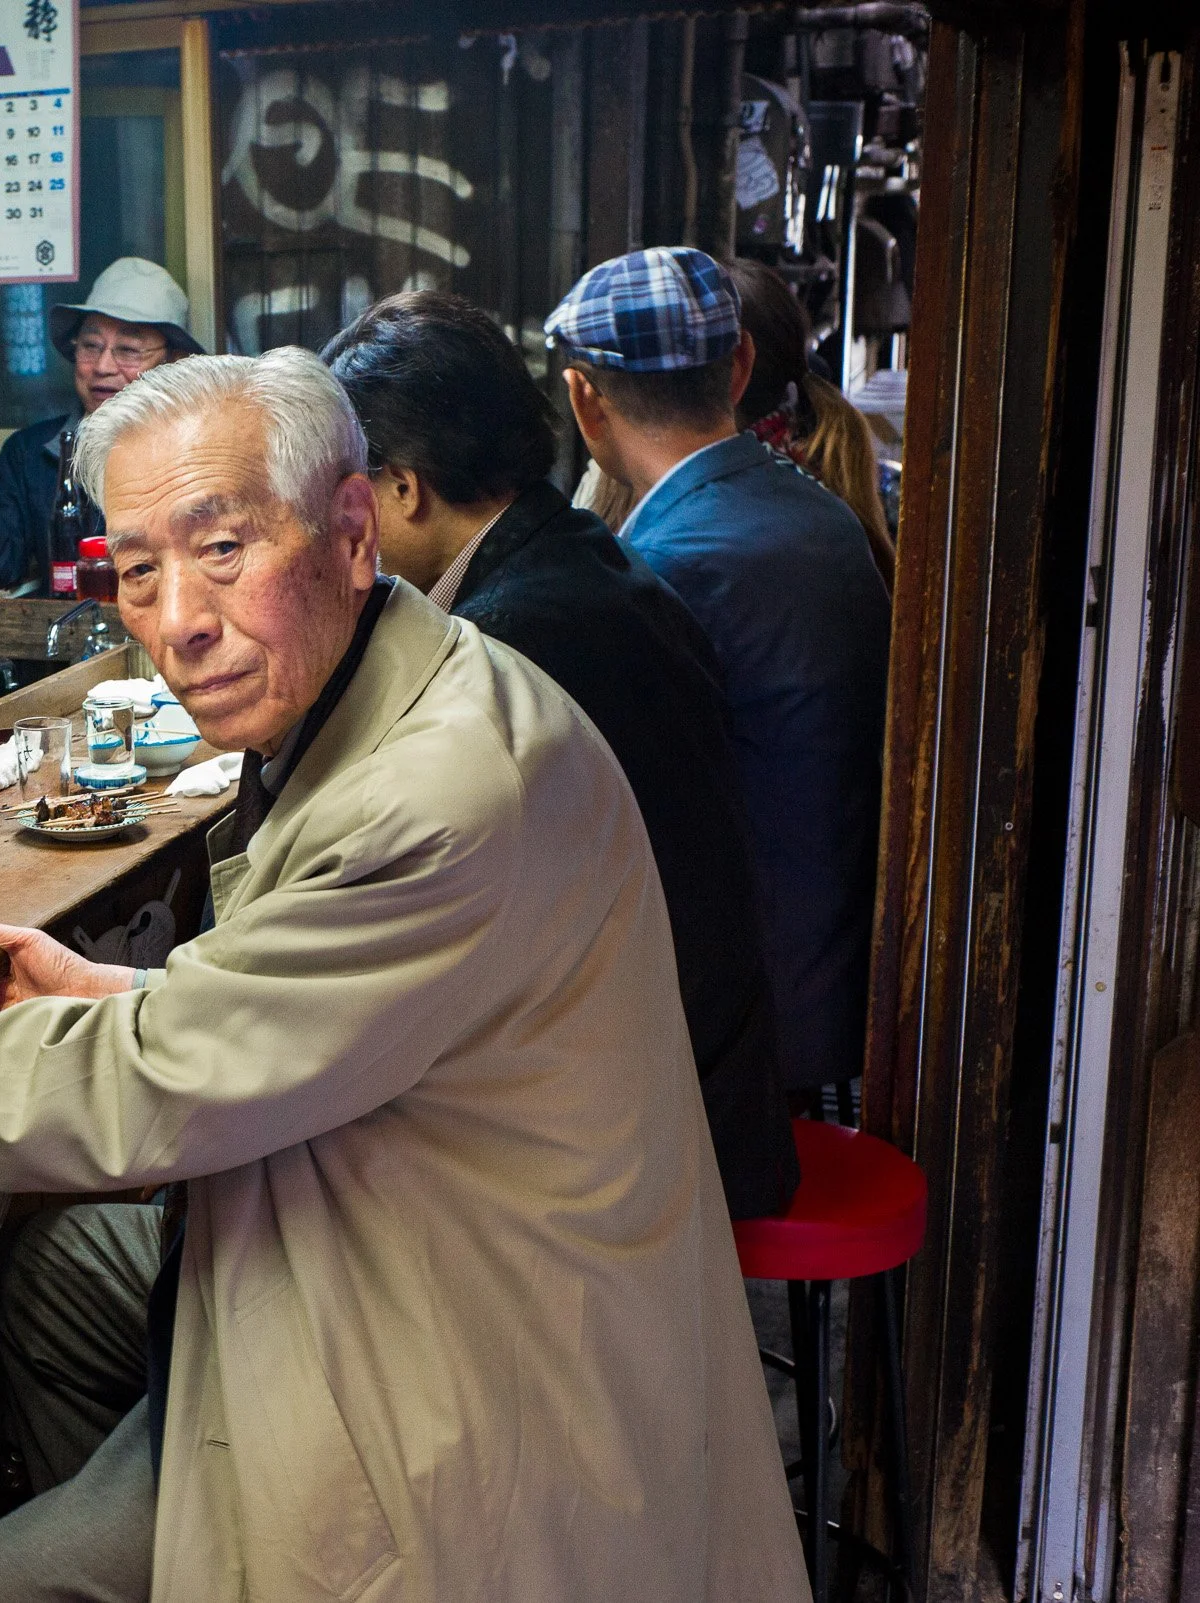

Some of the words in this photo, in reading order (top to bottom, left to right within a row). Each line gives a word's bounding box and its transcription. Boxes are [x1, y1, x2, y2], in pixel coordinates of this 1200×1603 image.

[6, 101, 15, 113] 2
[29, 100, 38, 111] 3
[54, 98, 63, 109] 4
[7, 128, 16, 140] 9
[27, 126, 41, 138] 10
[52, 125, 64, 136] 11
[5, 154, 19, 167] 16
[28, 153, 41, 165] 17
[50, 151, 64, 163] 18
[5, 181, 21, 193] 23
[28, 180, 43, 192] 24
[49, 178, 65, 191] 25
[6, 208, 22, 220] 30
[29, 206, 43, 219] 31
